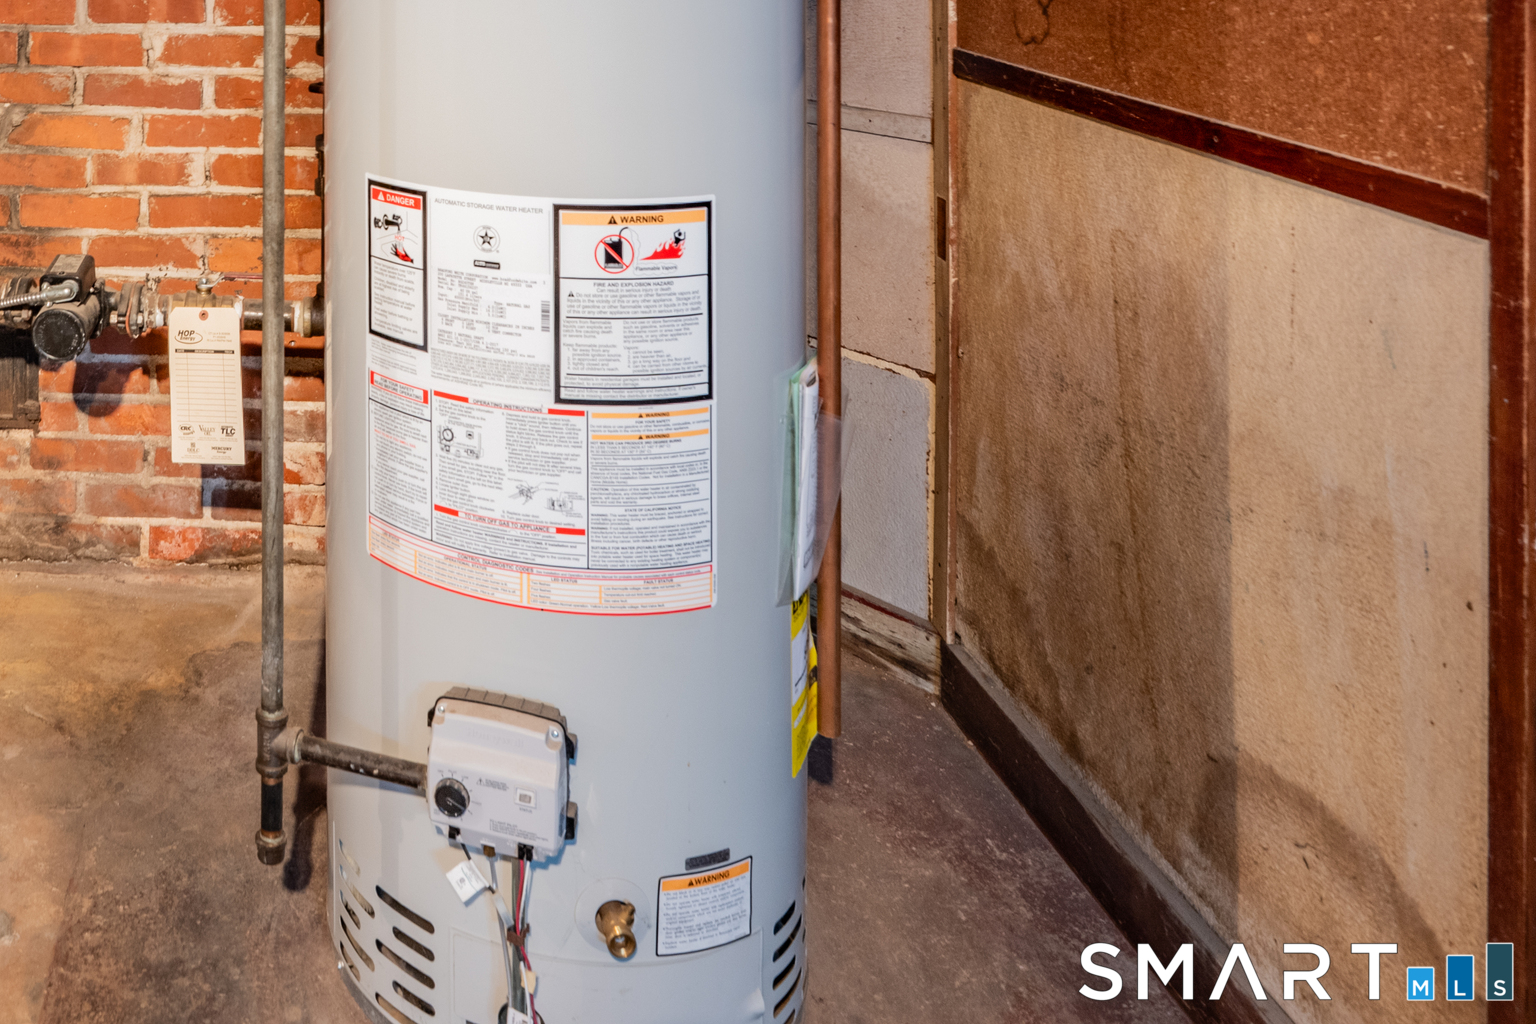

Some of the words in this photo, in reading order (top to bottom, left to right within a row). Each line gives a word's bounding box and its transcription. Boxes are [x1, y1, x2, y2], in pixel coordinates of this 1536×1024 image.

[386, 193, 414, 206] DANGER
[435, 198, 465, 208] AUTOMATIC
[466, 202, 494, 210] STORAGE
[496, 204, 517, 212] WATER
[620, 215, 664, 223] WARNING
[473, 399, 503, 408] OPERATING
[504, 404, 543, 413] INSTRUCTIONS
[472, 515, 486, 523] TURN
[519, 524, 549, 532] APPLIANCE
[457, 553, 480, 563] CONTROL
[482, 559, 514, 570] DIAGNOSTIC
[693, 870, 730, 886] WARNING
